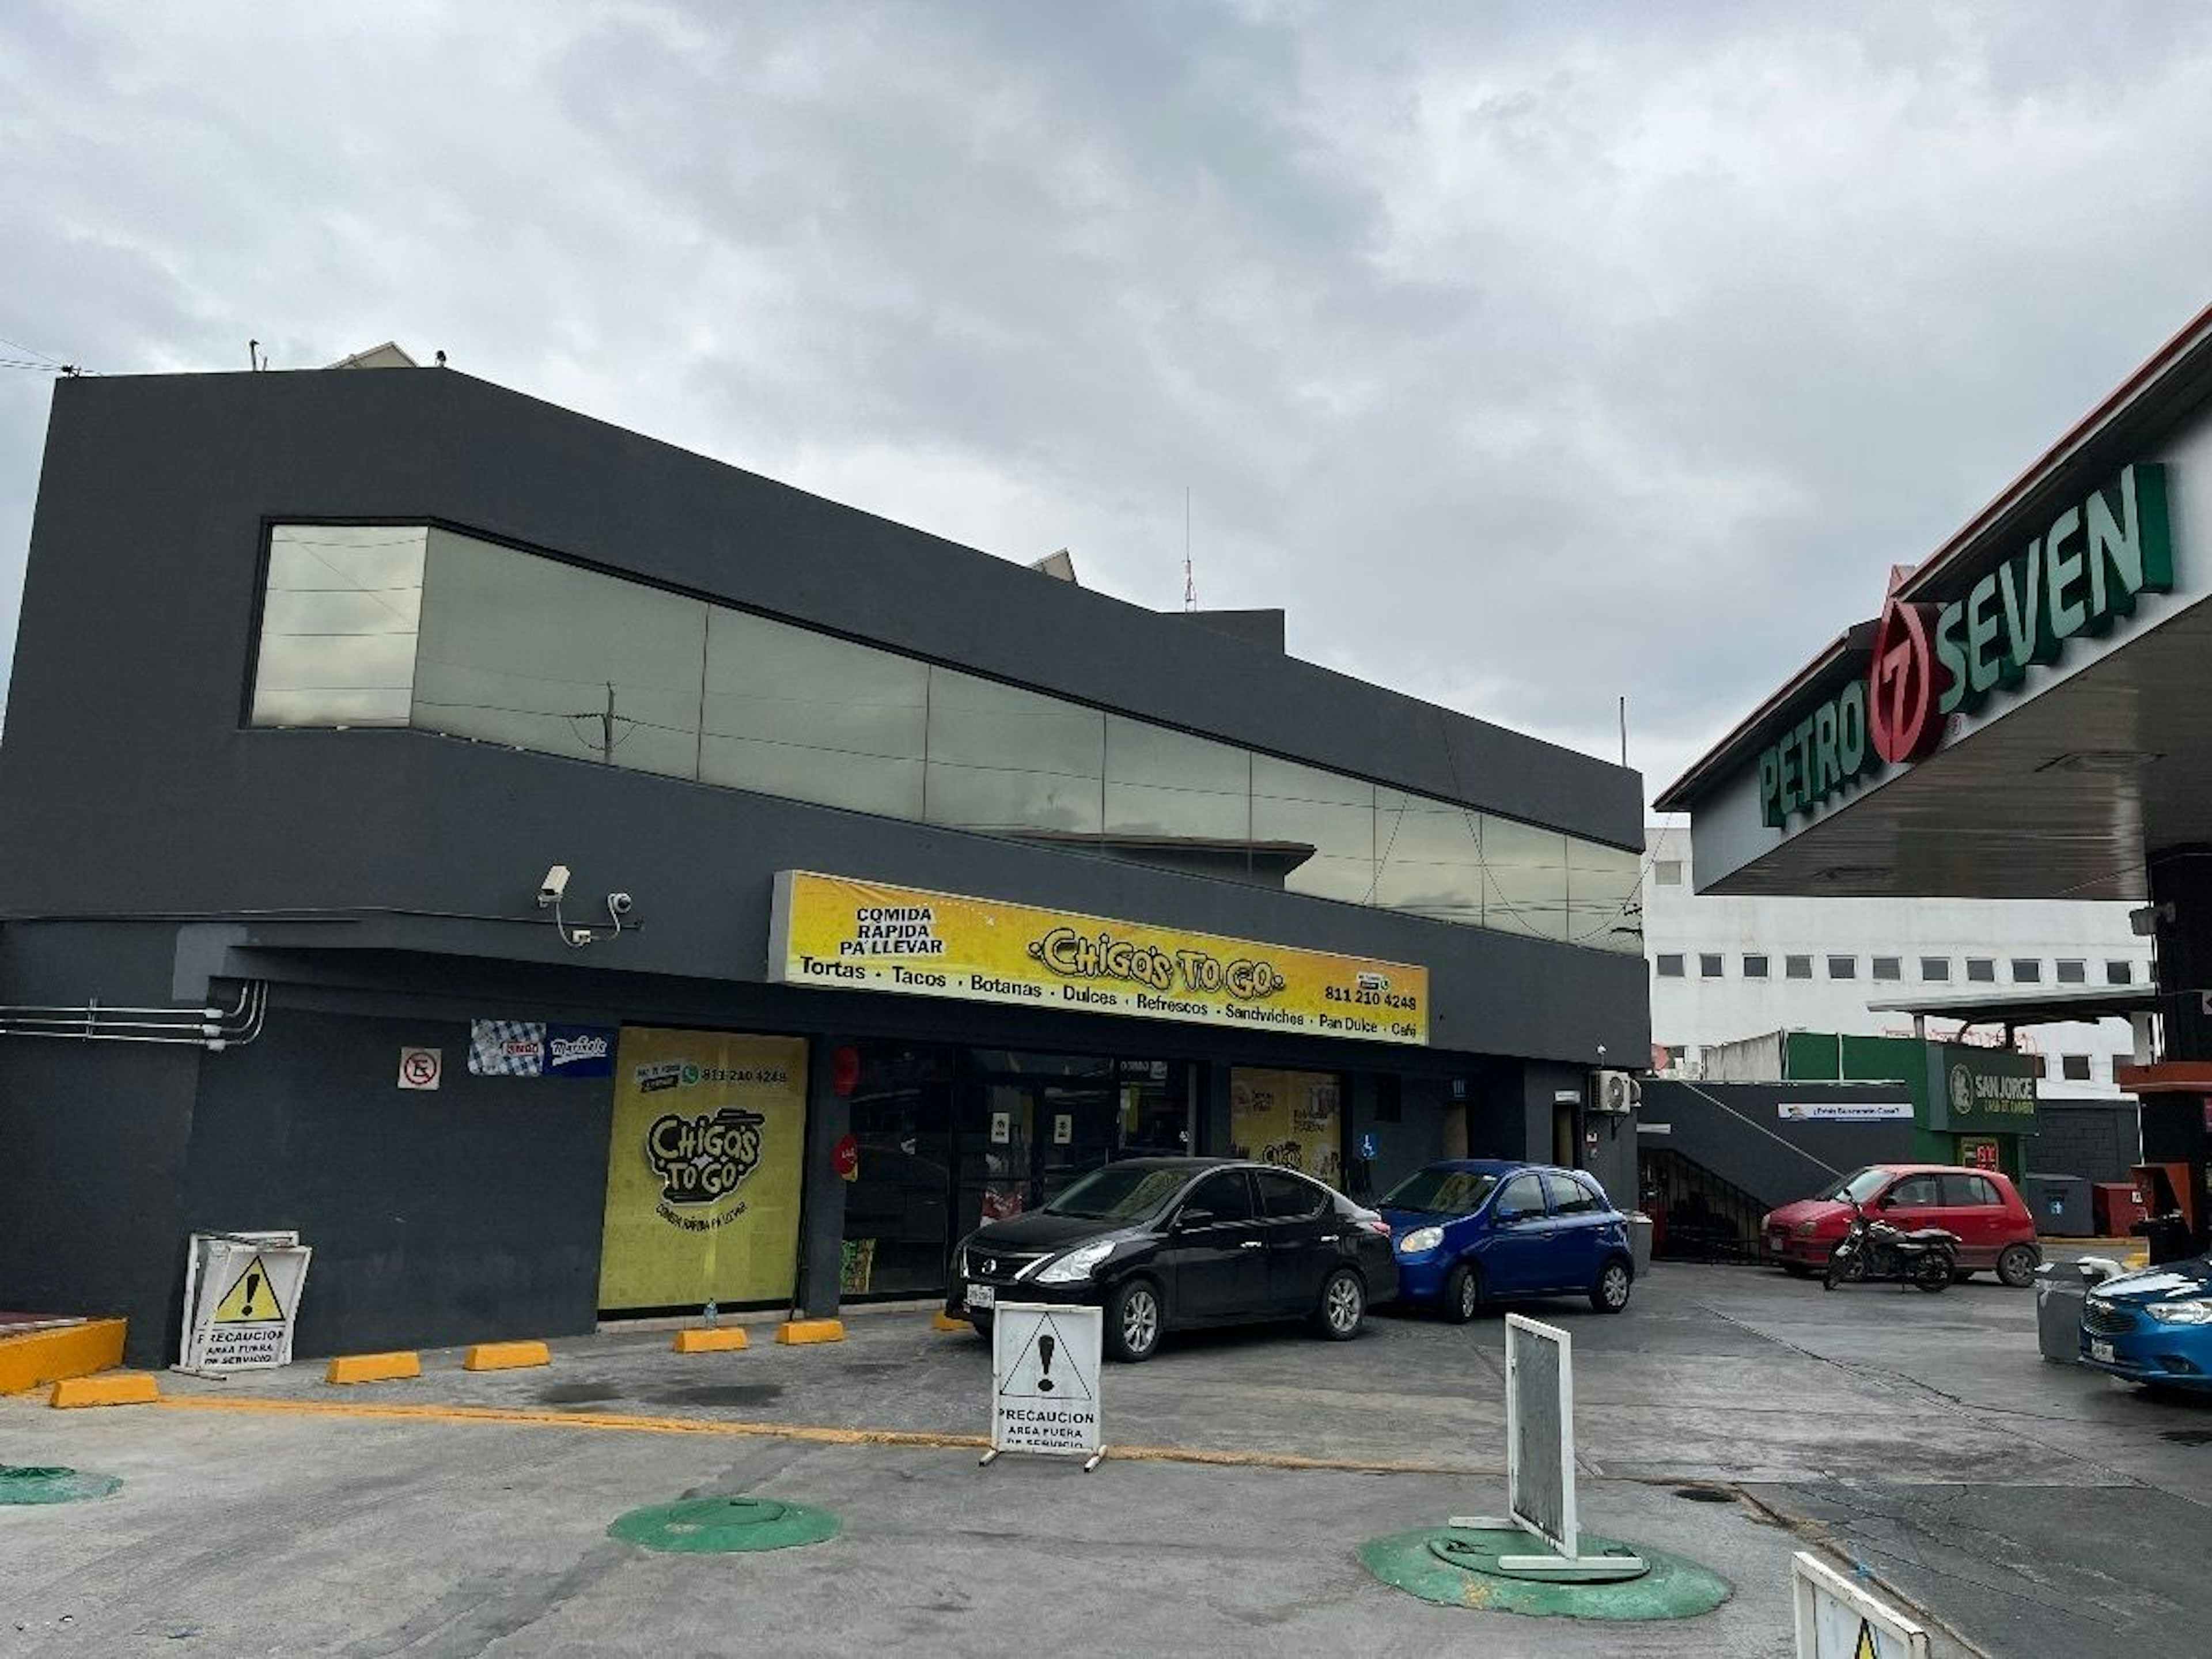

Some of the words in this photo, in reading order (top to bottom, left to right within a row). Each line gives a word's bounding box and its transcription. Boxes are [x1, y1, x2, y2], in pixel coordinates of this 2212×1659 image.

[1758, 680, 1875, 827] PETRO
[1936, 463, 2157, 714] SEVEN
[857, 908, 932, 922] COMIDA
[872, 939, 943, 955] LLEVAR
[1176, 949, 1221, 992] TO
[1225, 959, 1274, 1001] GO
[800, 956, 865, 980] Tortas
[892, 966, 947, 987] Tacos
[971, 975, 1042, 998] Botanas
[1063, 985, 1118, 1005] Dulces
[1137, 994, 1208, 1016] Refrescos
[1226, 1004, 1304, 1026] Sandwiches
[1319, 1014, 1342, 1029] Pan
[1346, 1017, 1378, 1033] Dulce
[1325, 986, 1351, 1002] 811
[1355, 990, 1380, 1005] 210
[1975, 1075, 1999, 1099] SAN
[666, 1162, 697, 1190] TO
[701, 1162, 737, 1194] GO
[999, 1408, 1094, 1423] PRECAUCION
[1009, 1426, 1039, 1435] AREA
[1043, 1428, 1083, 1438] FUERA
